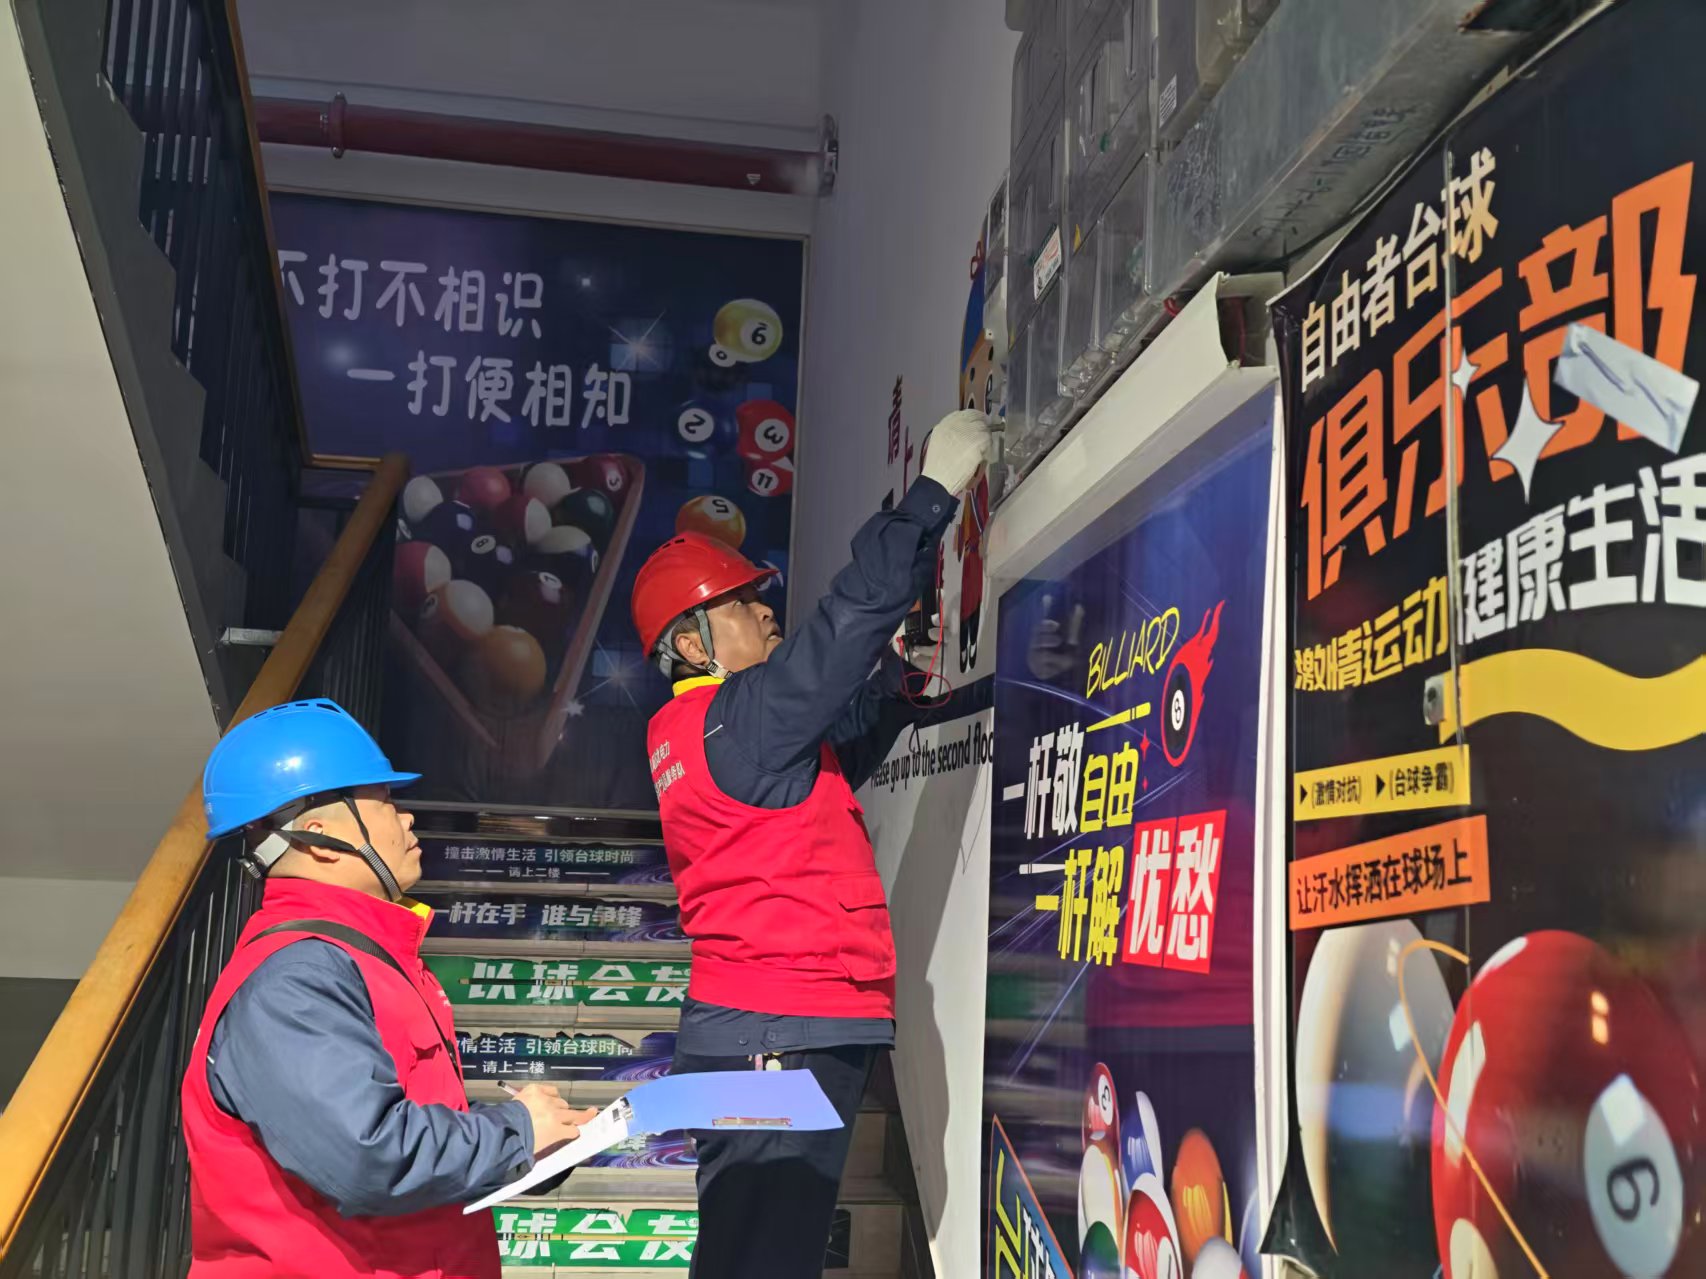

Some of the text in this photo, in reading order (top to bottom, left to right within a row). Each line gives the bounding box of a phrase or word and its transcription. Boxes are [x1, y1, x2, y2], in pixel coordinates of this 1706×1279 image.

[1301, 147, 1499, 392] 自由者台球
[347, 350, 632, 428] 一打便相知
[1300, 161, 1697, 601] 俱乐部
[757, 472, 772, 489] 11
[1294, 449, 1706, 692] 激情运动 健康生活
[901, 753, 911, 790] up
[922, 739, 936, 777] the
[937, 724, 972, 774] second
[1003, 721, 1139, 841] 一杆敬自由
[445, 845, 634, 864] 撞击激情生活 引领台球时尚
[1296, 837, 1473, 915] 让汗水挥洒在球场上
[433, 901, 643, 928] 一杆在手 谁与争锋
[1035, 822, 1222, 967] 一杆解忧愁
[455, 1037, 634, 1056] 情生活 引领台球时尚
[482, 1060, 545, 1075] 请上二楼
